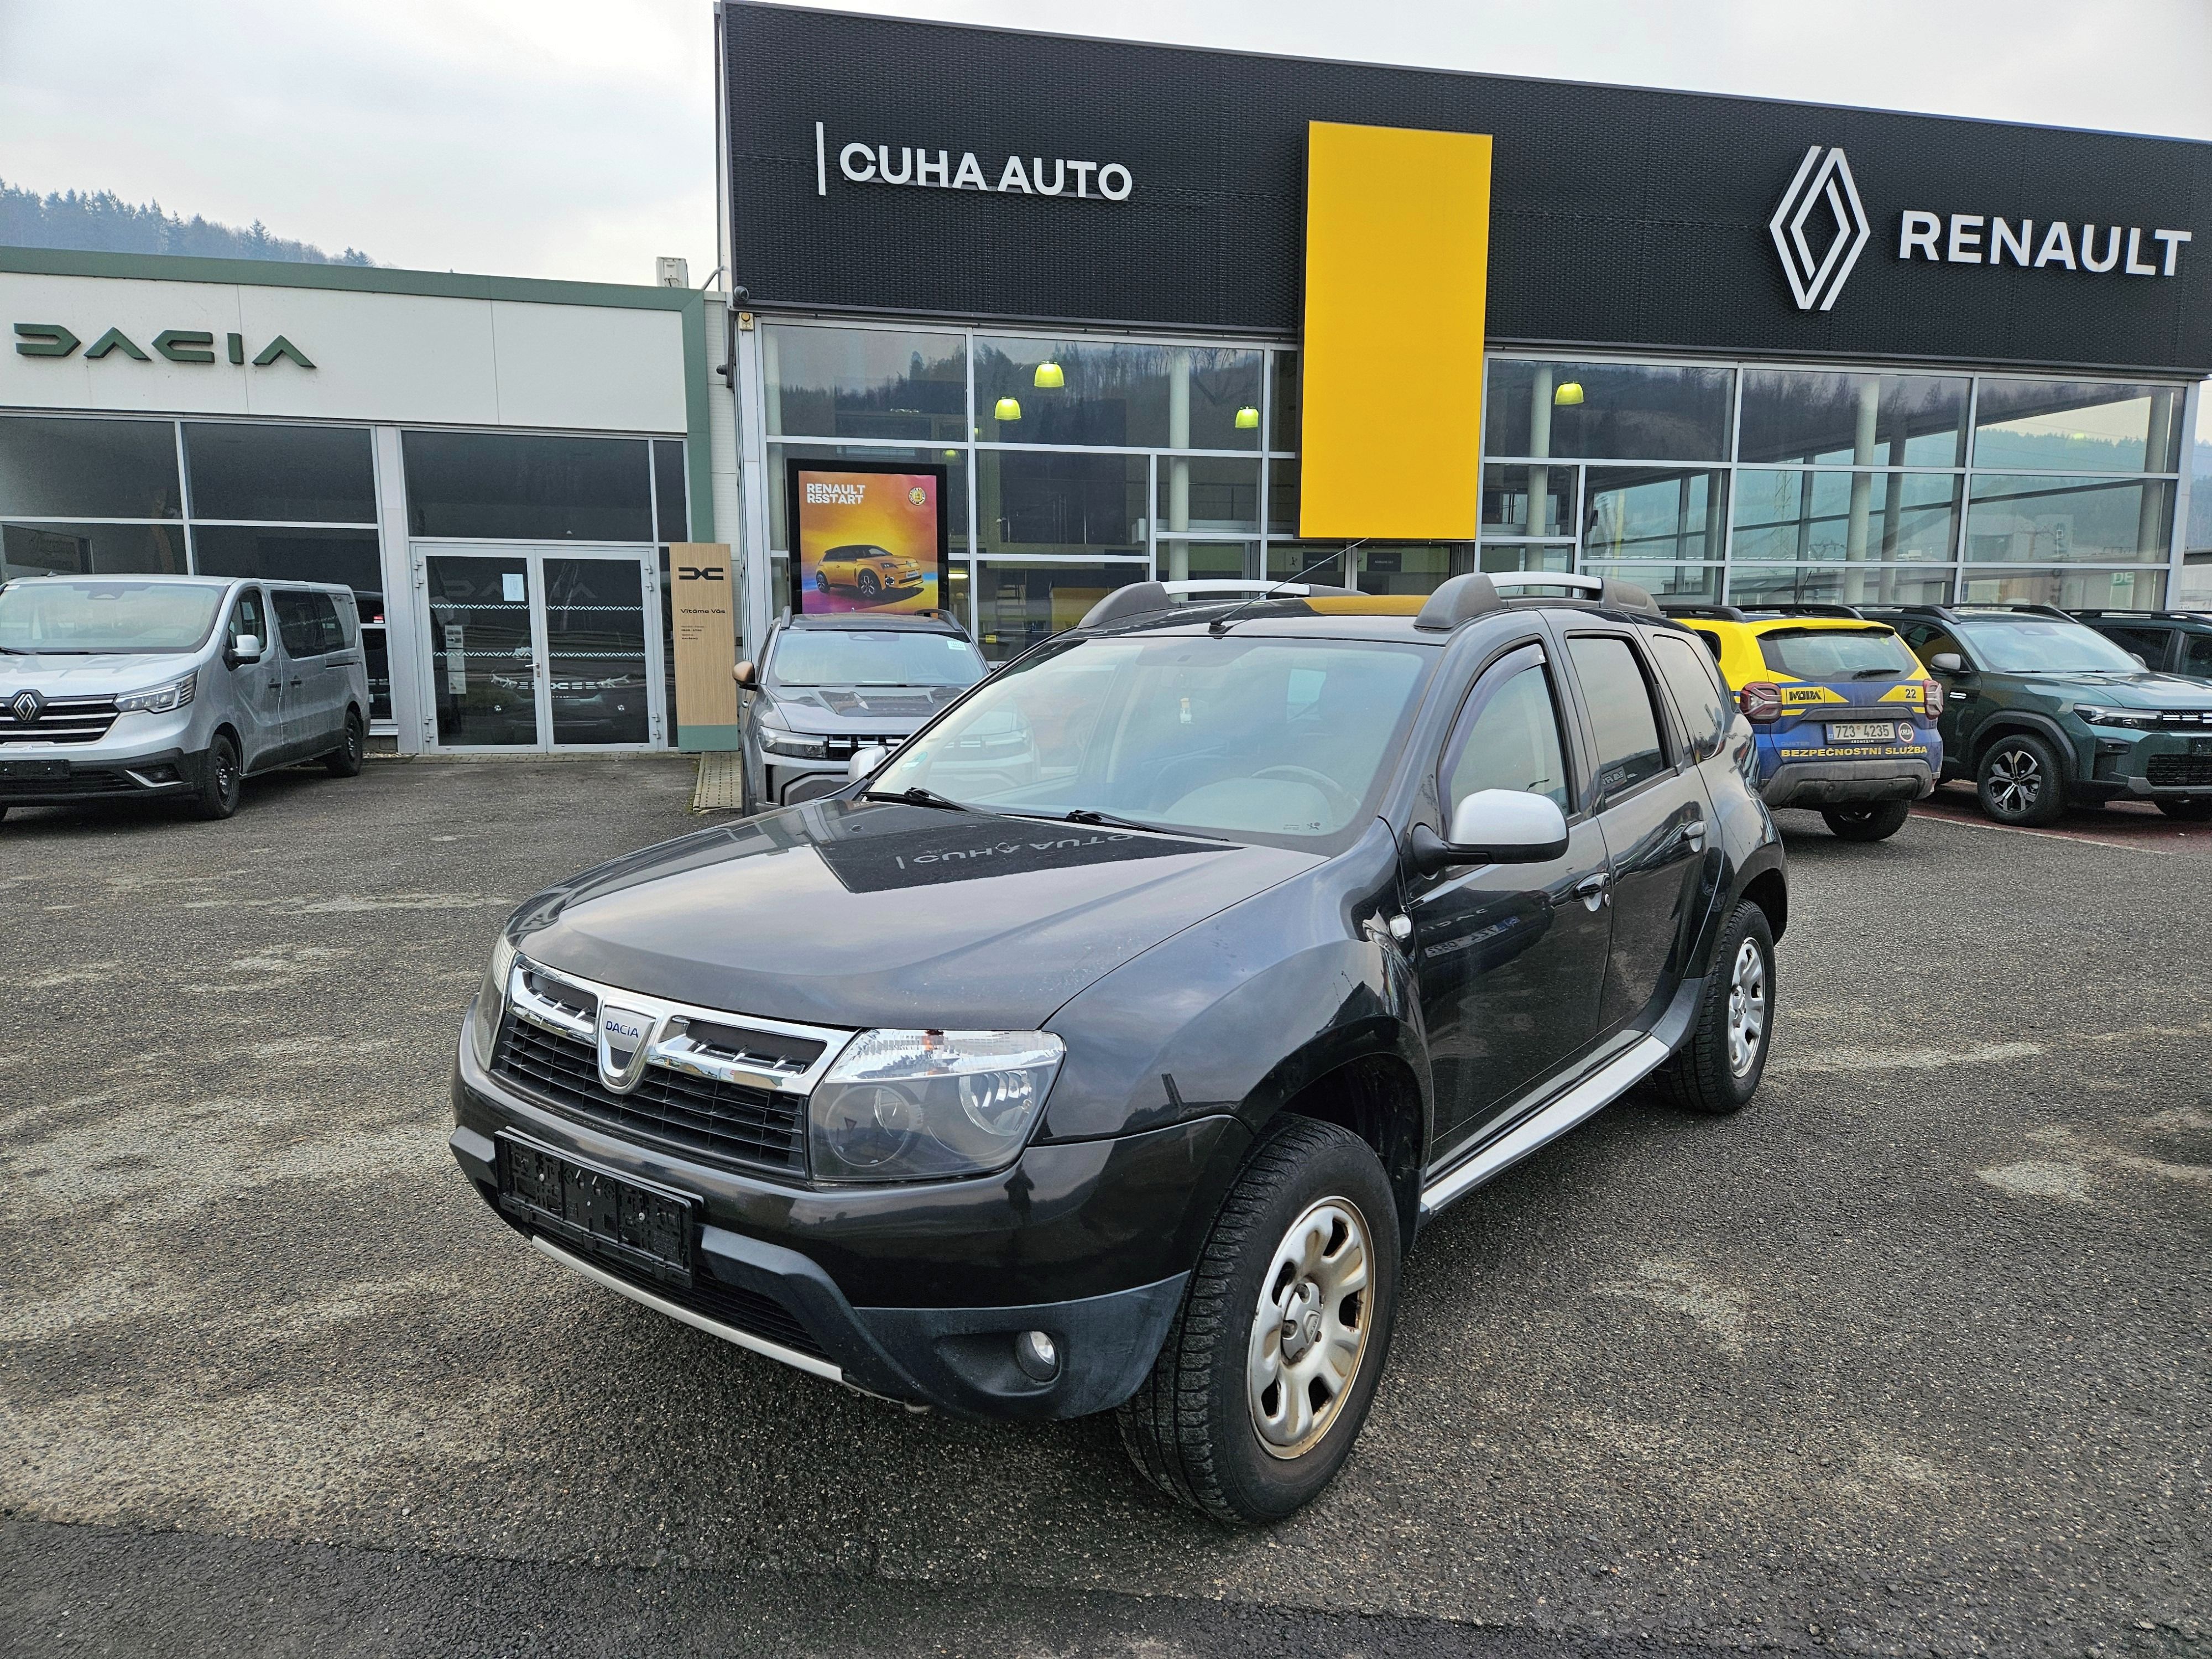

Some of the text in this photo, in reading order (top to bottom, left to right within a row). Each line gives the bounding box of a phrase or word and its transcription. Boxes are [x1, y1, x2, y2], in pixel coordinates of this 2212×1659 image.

[840, 142, 1133, 201] CUHA AUTO
[1899, 210, 2192, 277] RENAULT
[13, 322, 317, 369] DACIA
[806, 483, 865, 494] RENAULT
[807, 493, 864, 504] R5START
[1905, 688, 1917, 699] 22
[1835, 725, 1856, 738] 7Z3
[1864, 724, 1890, 737] 4235
[1781, 745, 1928, 757] BEZPEČNOSTNÍ SLUŽBA
[606, 1020, 639, 1038] DACIA
